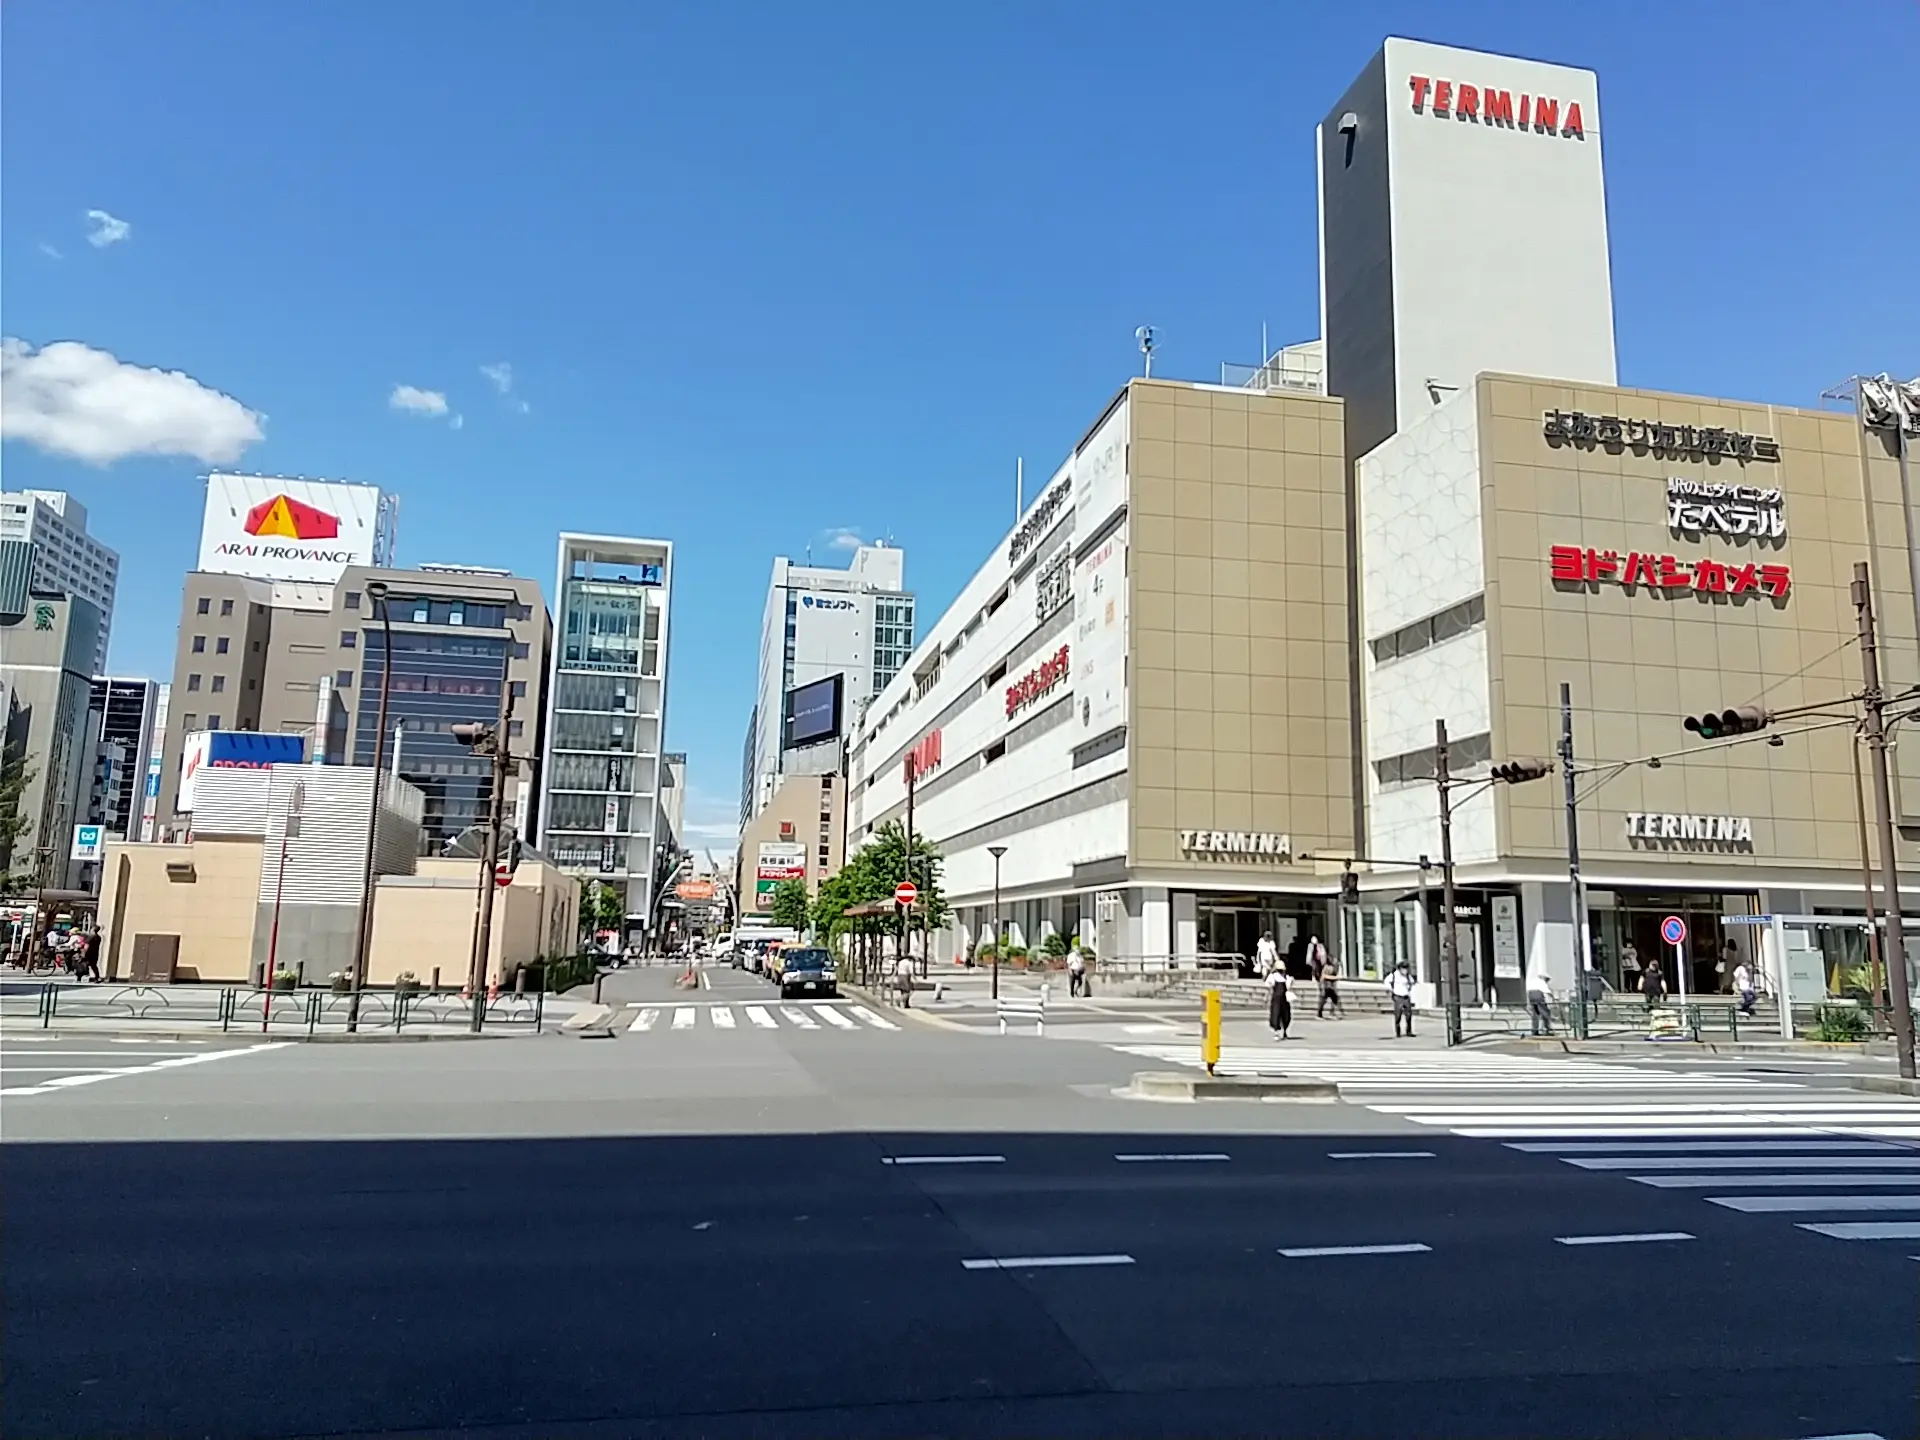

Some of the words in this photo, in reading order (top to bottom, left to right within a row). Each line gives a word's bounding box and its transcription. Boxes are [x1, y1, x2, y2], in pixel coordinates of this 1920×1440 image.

[1410, 75, 1584, 134] TERMINA
[1544, 409, 1780, 461] よみうりカルチャー
[214, 543, 259, 556] ARAI
[262, 546, 359, 564] PROVANCE
[1552, 545, 1790, 597] ヨドバシカメラ
[1180, 829, 1291, 855] TERMINA
[1626, 812, 1753, 841] TERMINA
